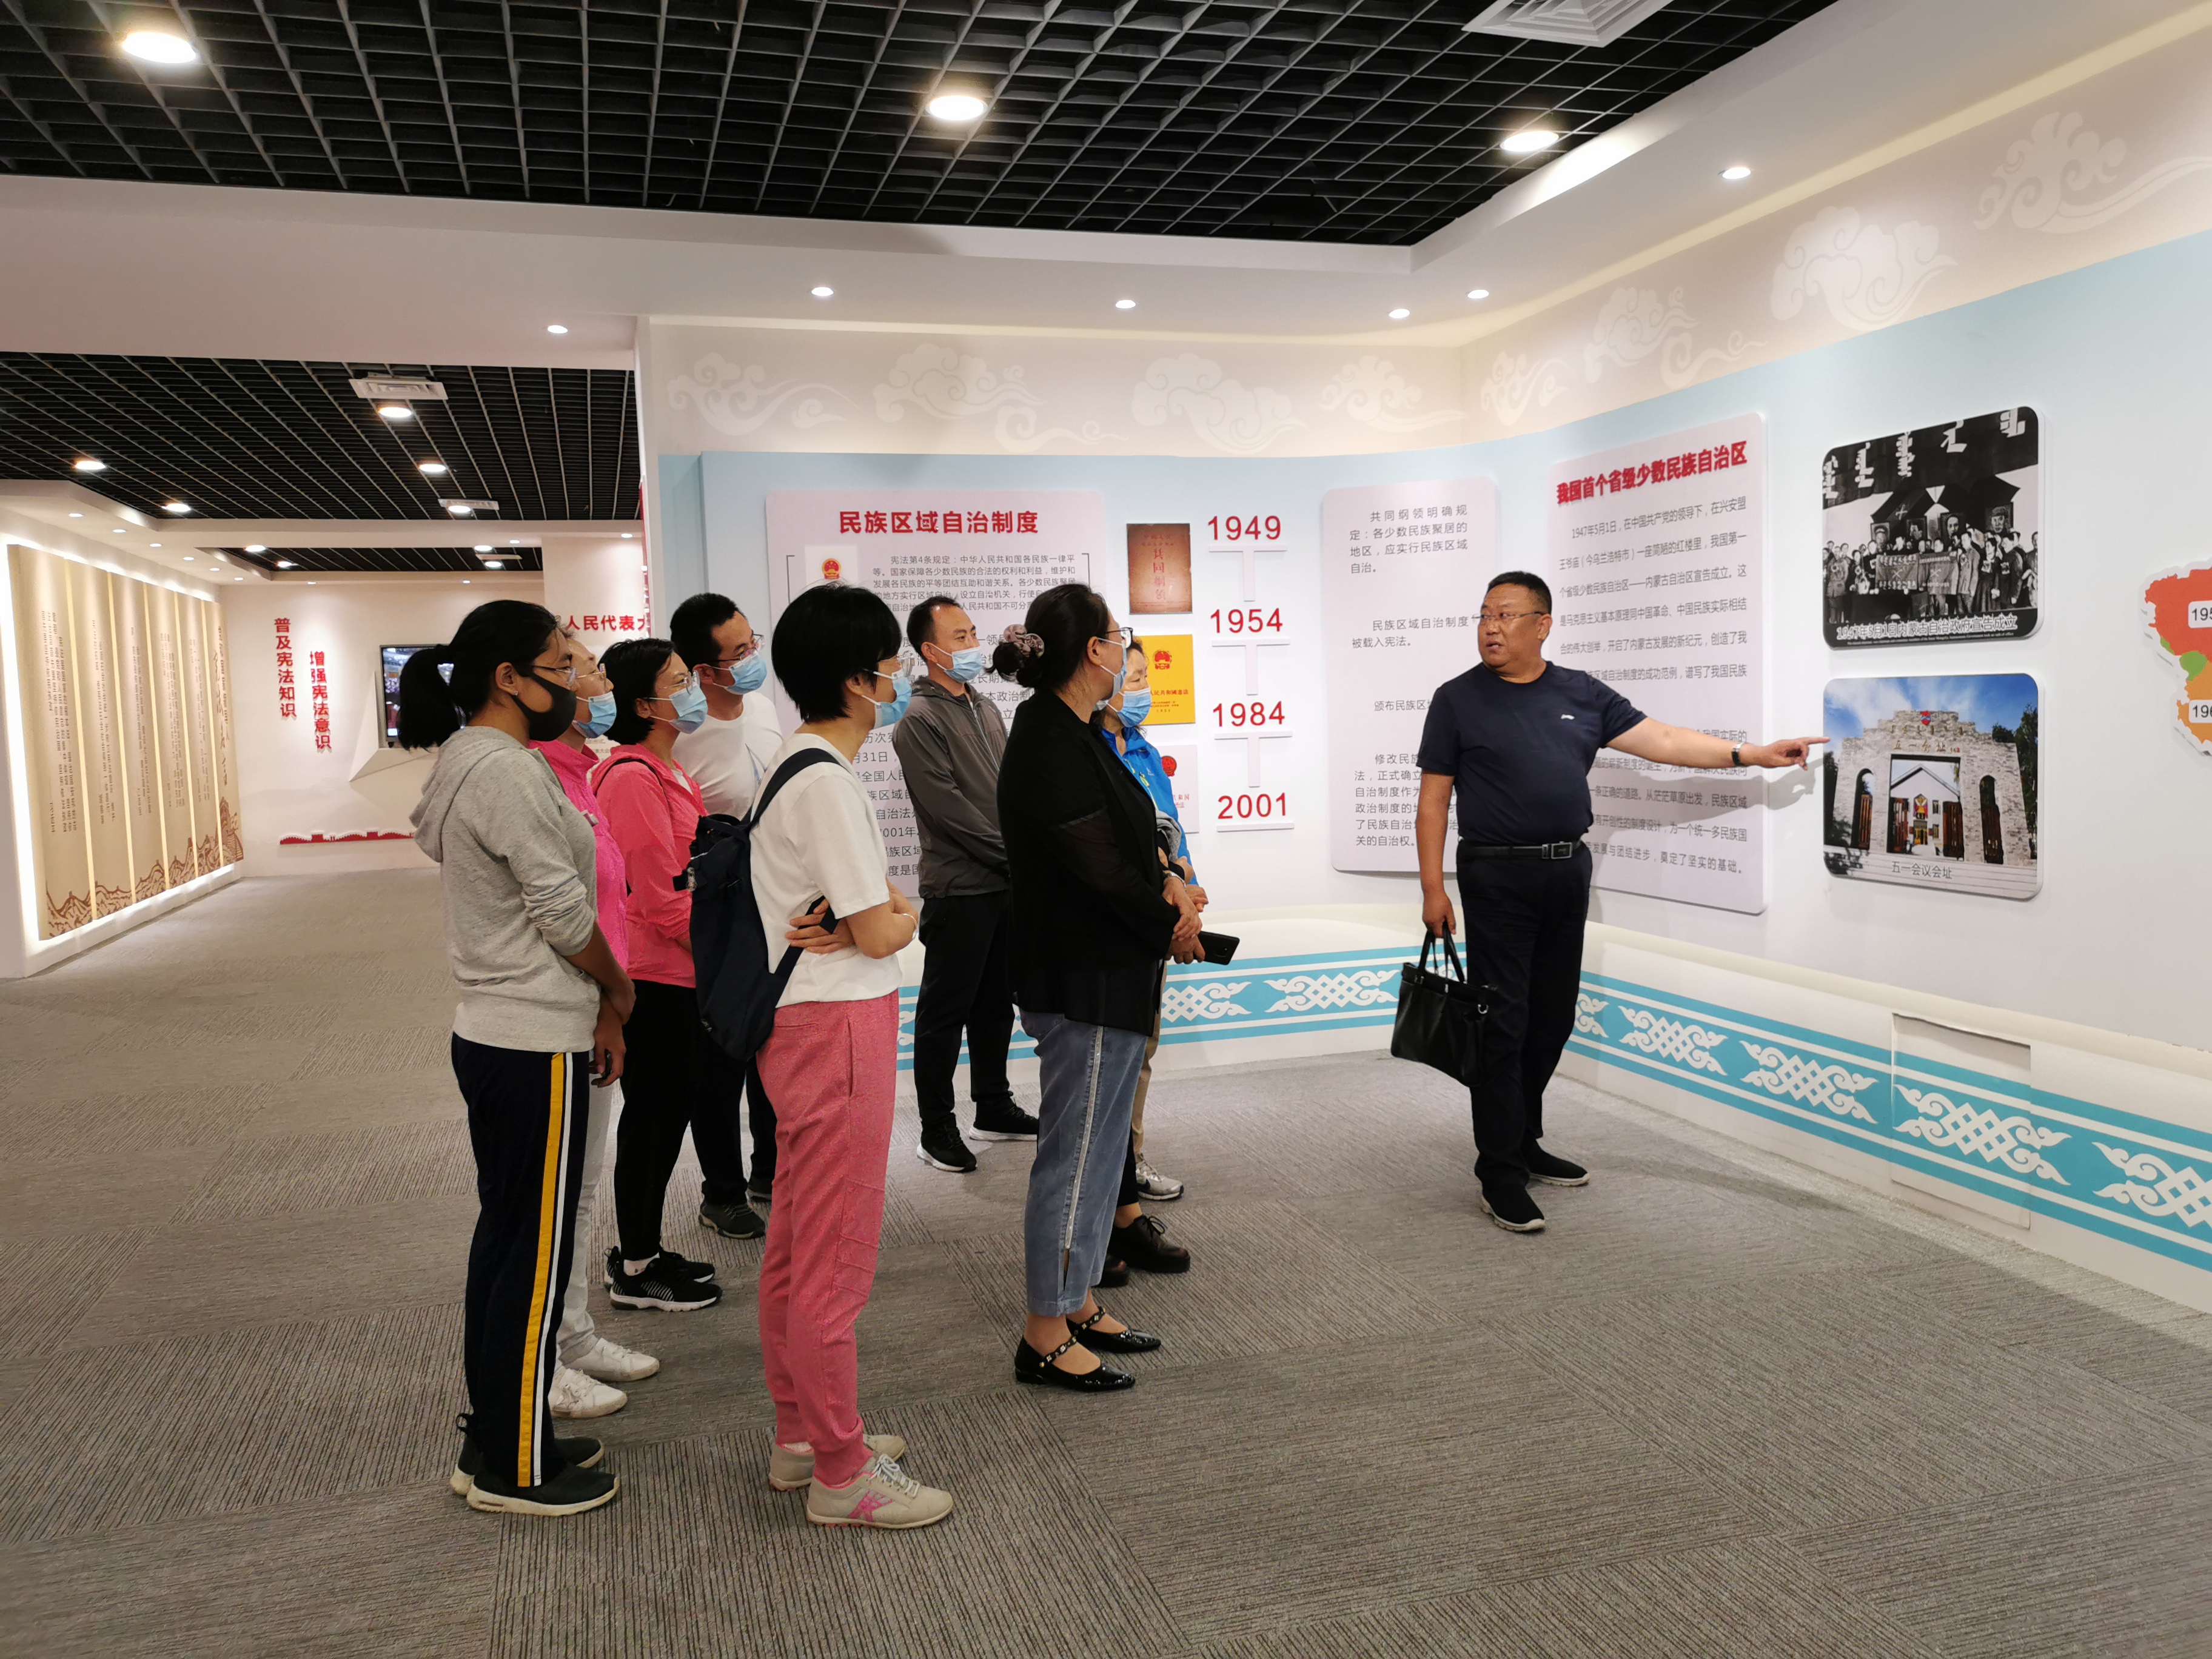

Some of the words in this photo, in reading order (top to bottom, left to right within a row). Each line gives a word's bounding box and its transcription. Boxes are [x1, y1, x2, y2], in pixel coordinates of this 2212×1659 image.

[1557, 440, 1748, 504] 我国首个省级少数民族自治区
[1370, 504, 1467, 522] 共同纲领明确规
[840, 511, 1039, 534] 民族区域自治制度
[1208, 516, 1281, 540] 1949
[1350, 522, 1467, 540] 定：各少数民族聚居的
[1350, 539, 1468, 557] 地区，应实行民族区域
[891, 554, 1075, 565] 宪法第4条规定：中华人民共和国各民族一律平
[1351, 563, 1376, 574] 自治。
[873, 566, 1076, 576] 等。国家保障各少数民族的合法的权利和利益，维护和
[1210, 608, 1283, 633] 1954
[1836, 612, 2019, 640] 1947年5月1日内蒙古自治政府宣告成立
[1352, 636, 1412, 649] 被载入宪法。
[274, 617, 297, 717] 普及宪法知识
[310, 651, 332, 749] 增强宪法意识
[1213, 701, 1285, 728] 1984
[1355, 770, 1422, 781] 法，正式确立
[1217, 792, 1287, 819] 2001
[1356, 836, 1415, 846] 关的自治权。
[1892, 861, 1952, 879] 五一会议会址
